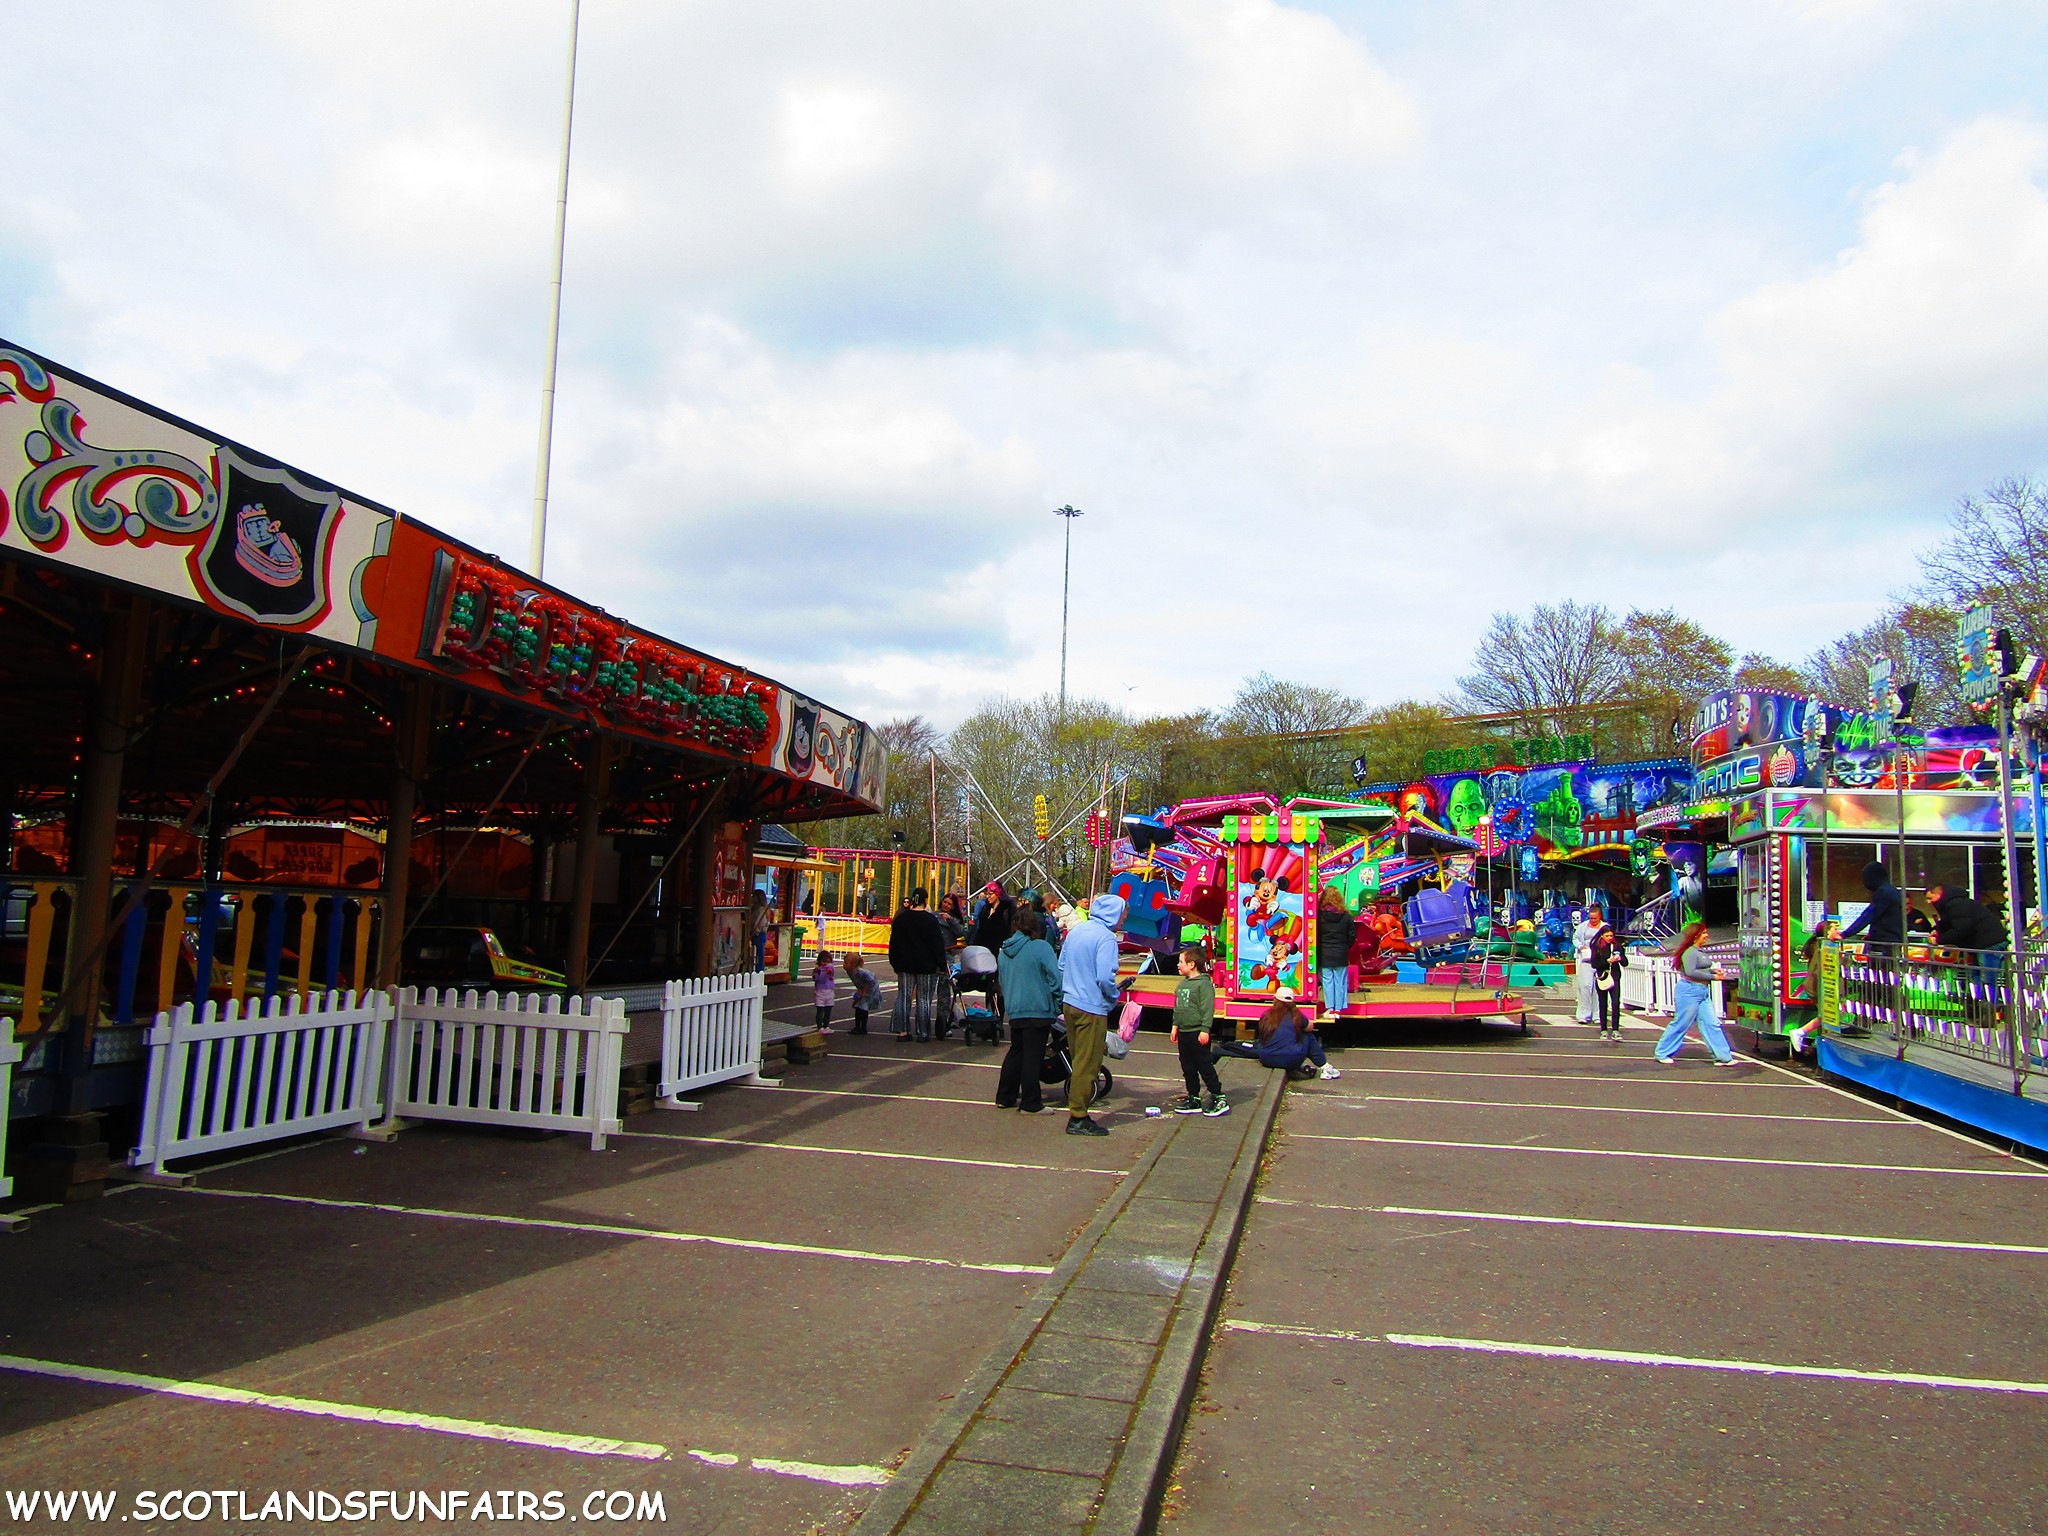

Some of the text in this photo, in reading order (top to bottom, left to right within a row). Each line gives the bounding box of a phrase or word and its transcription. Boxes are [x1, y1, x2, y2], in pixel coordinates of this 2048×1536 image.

[1957, 605, 1992, 638] TURBO
[419, 549, 779, 755] DODGEMS
[1962, 674, 1998, 700] POWER
[1423, 732, 1592, 773] GHOST TRAIN
